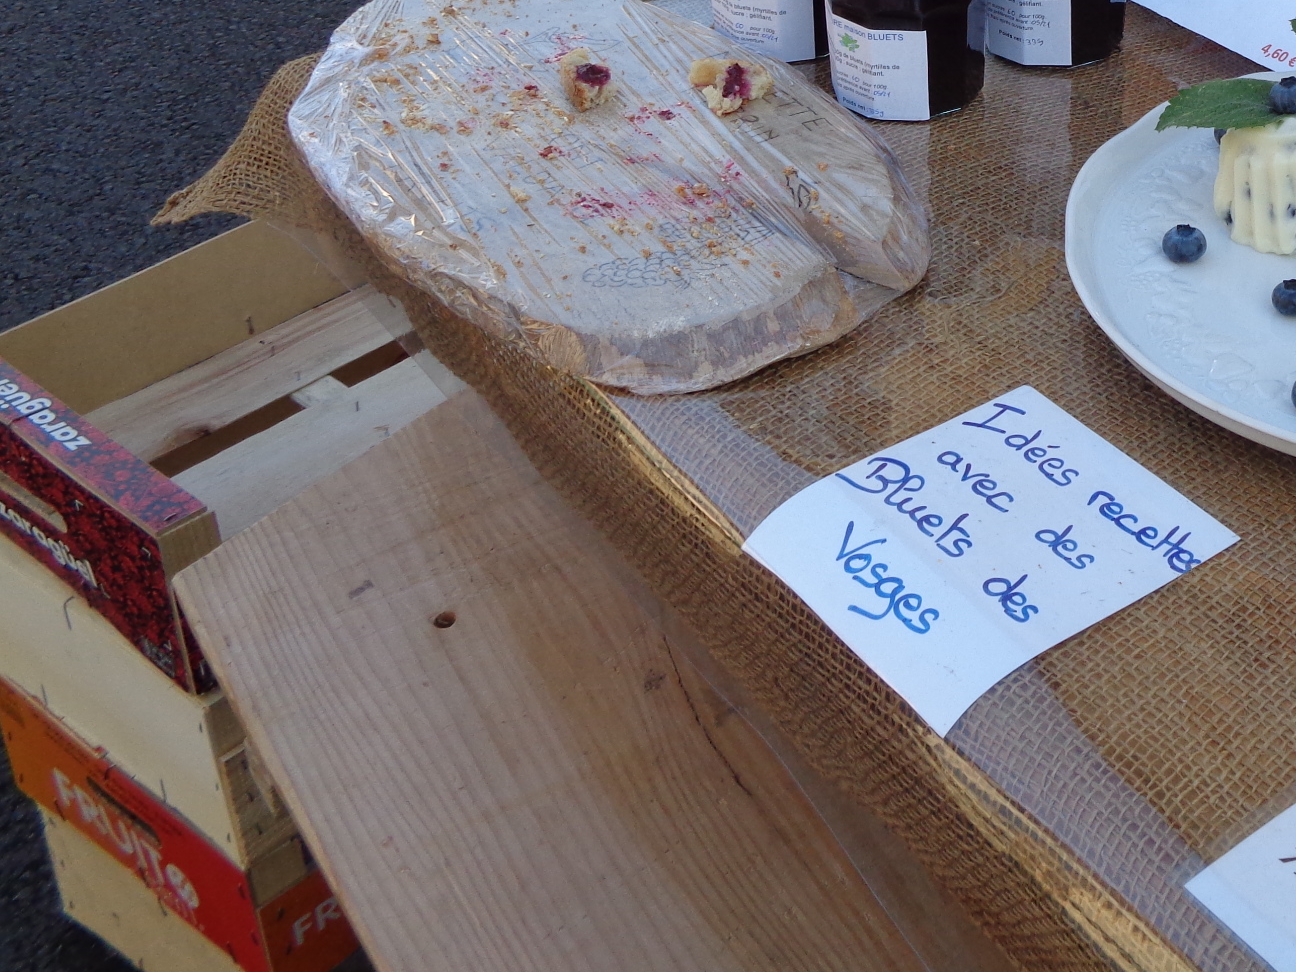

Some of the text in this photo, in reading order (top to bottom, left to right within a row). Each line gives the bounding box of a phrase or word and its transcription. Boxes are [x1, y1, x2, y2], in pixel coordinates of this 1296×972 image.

[844, 24, 904, 41] maison BLUETS
[998, 29, 1013, 39] Poids
[1261, 43, 1291, 63] 4,60
[842, 96, 857, 107] Poids
[0, 379, 92, 451] zaragüe
[936, 450, 1095, 570] avec des
[962, 402, 1203, 574] Idées recettes
[835, 456, 1039, 624] Bluets des
[835, 521, 940, 635] Vosges
[51, 766, 165, 887] FRUIT
[290, 897, 342, 947] FR
